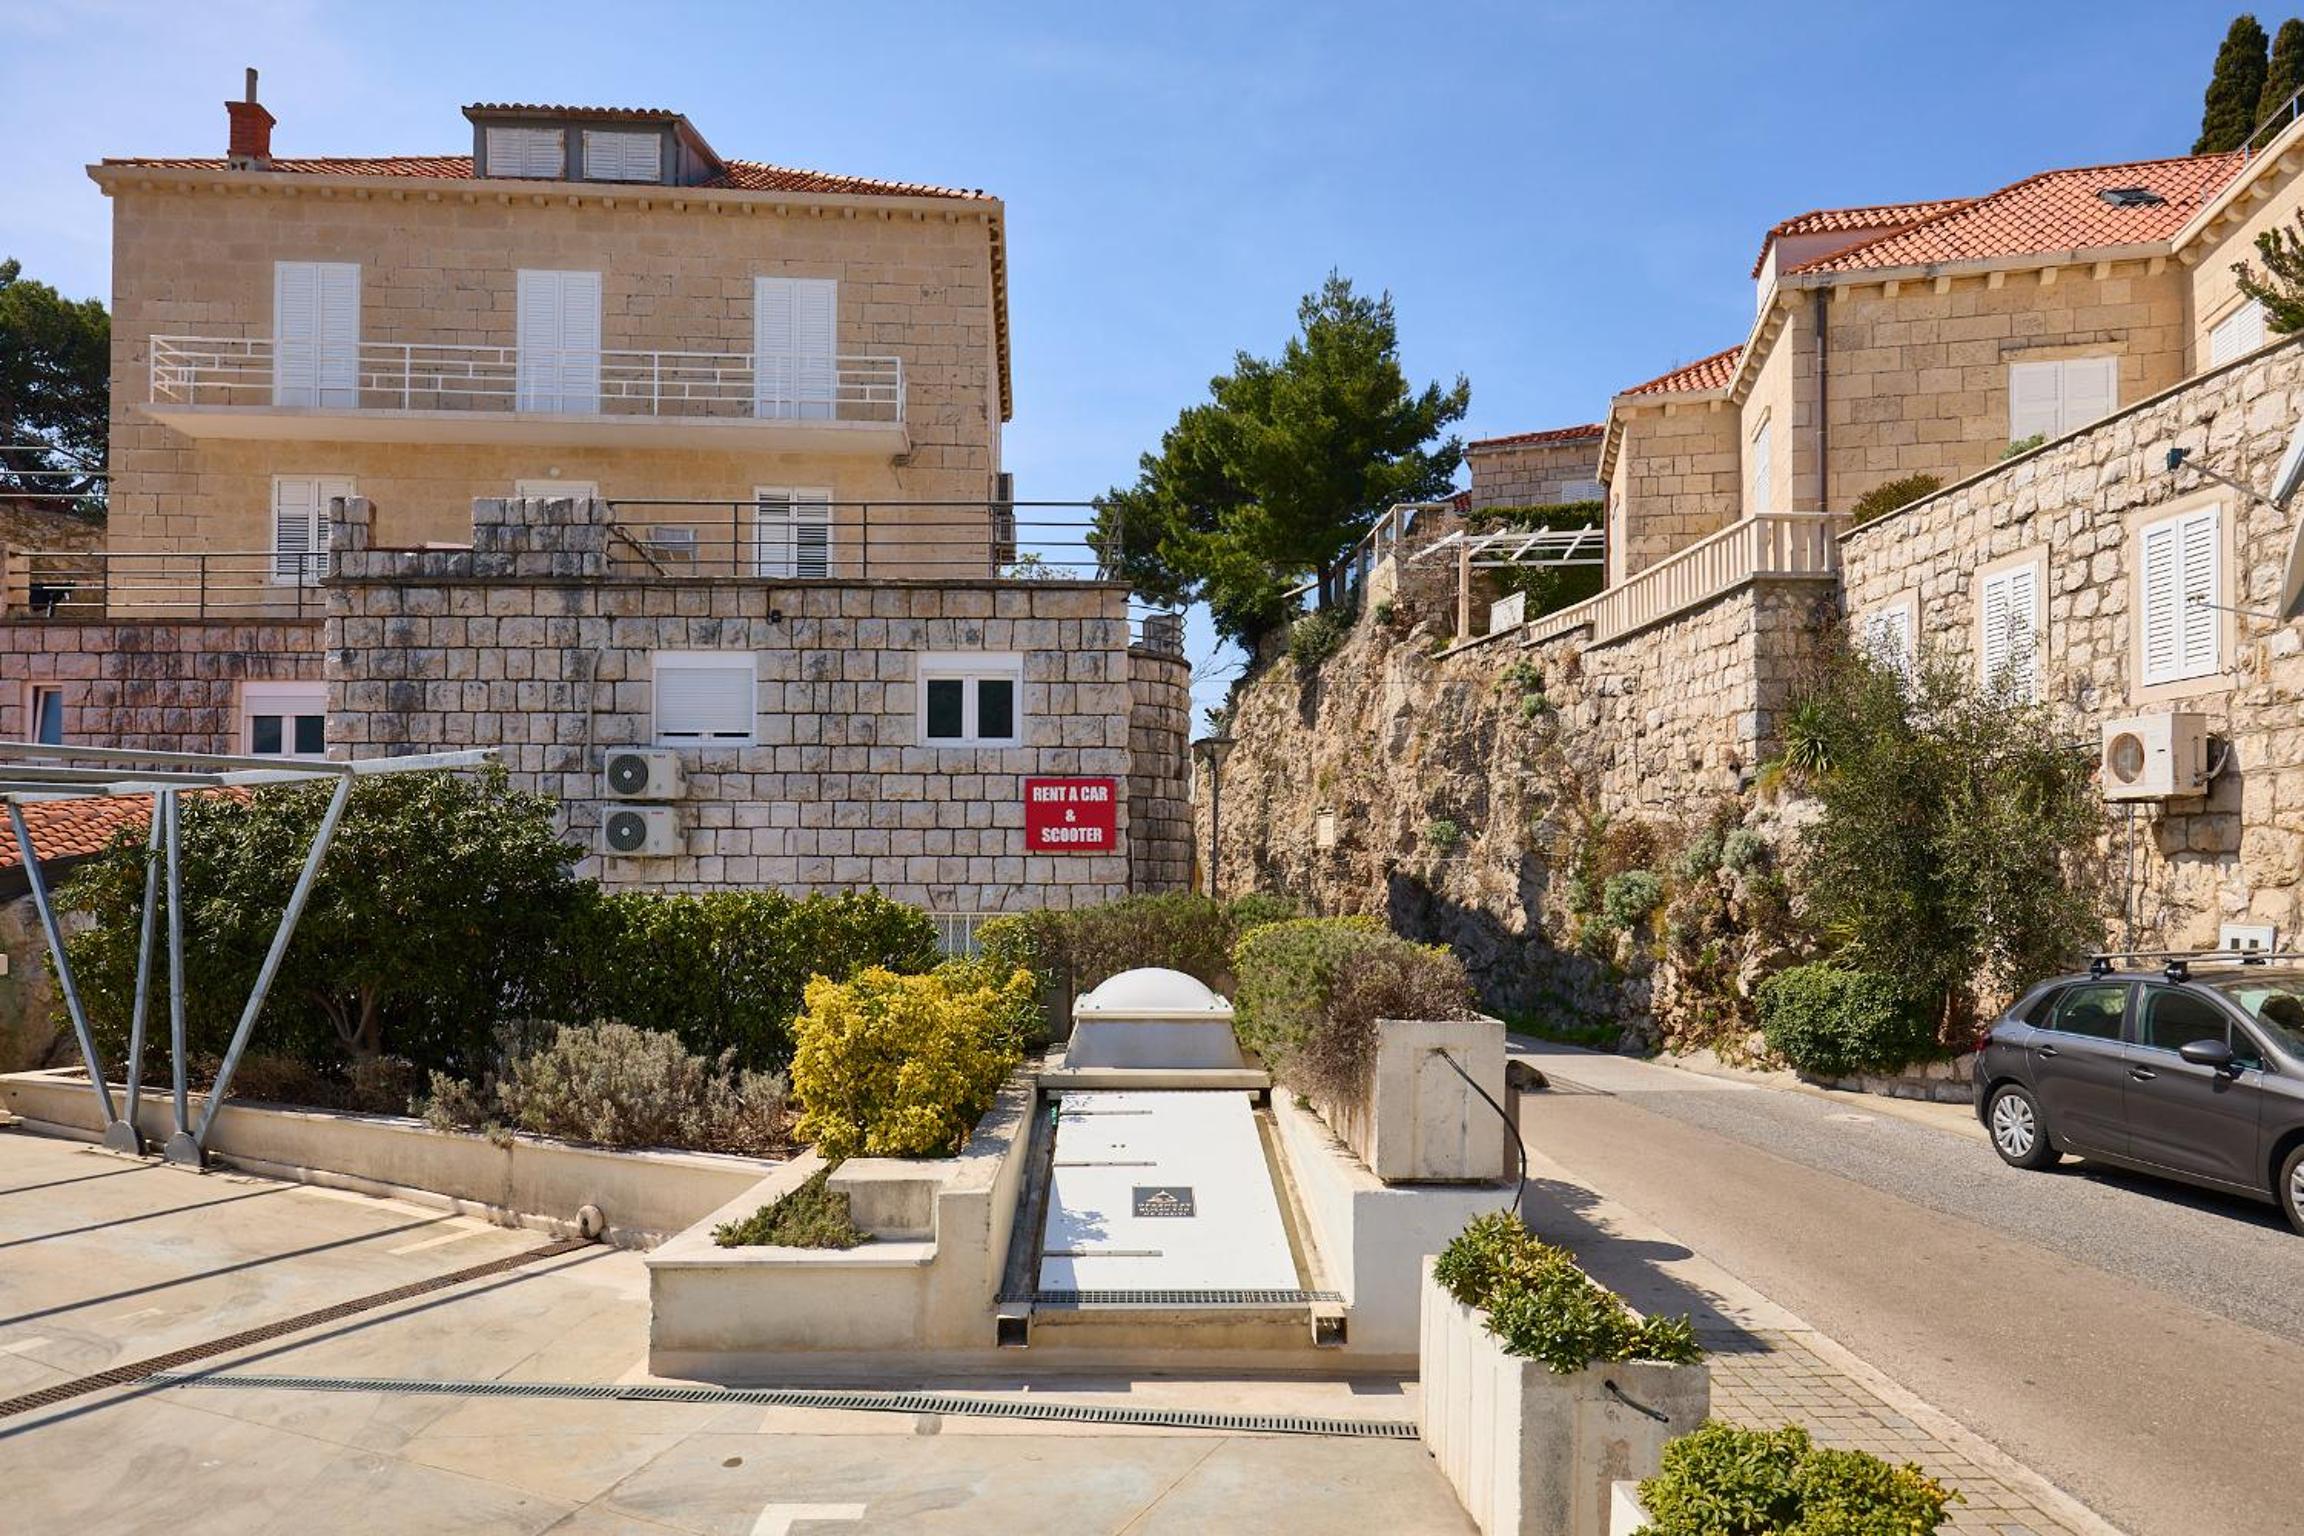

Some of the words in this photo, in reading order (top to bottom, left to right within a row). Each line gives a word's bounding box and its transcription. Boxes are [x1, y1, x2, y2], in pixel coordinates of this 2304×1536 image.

[1033, 786, 1066, 802] RENT
[1068, 786, 1078, 802] A
[1081, 786, 1108, 802] CAR
[1065, 808, 1076, 822] &
[1041, 827, 1102, 843] SCOOTER
